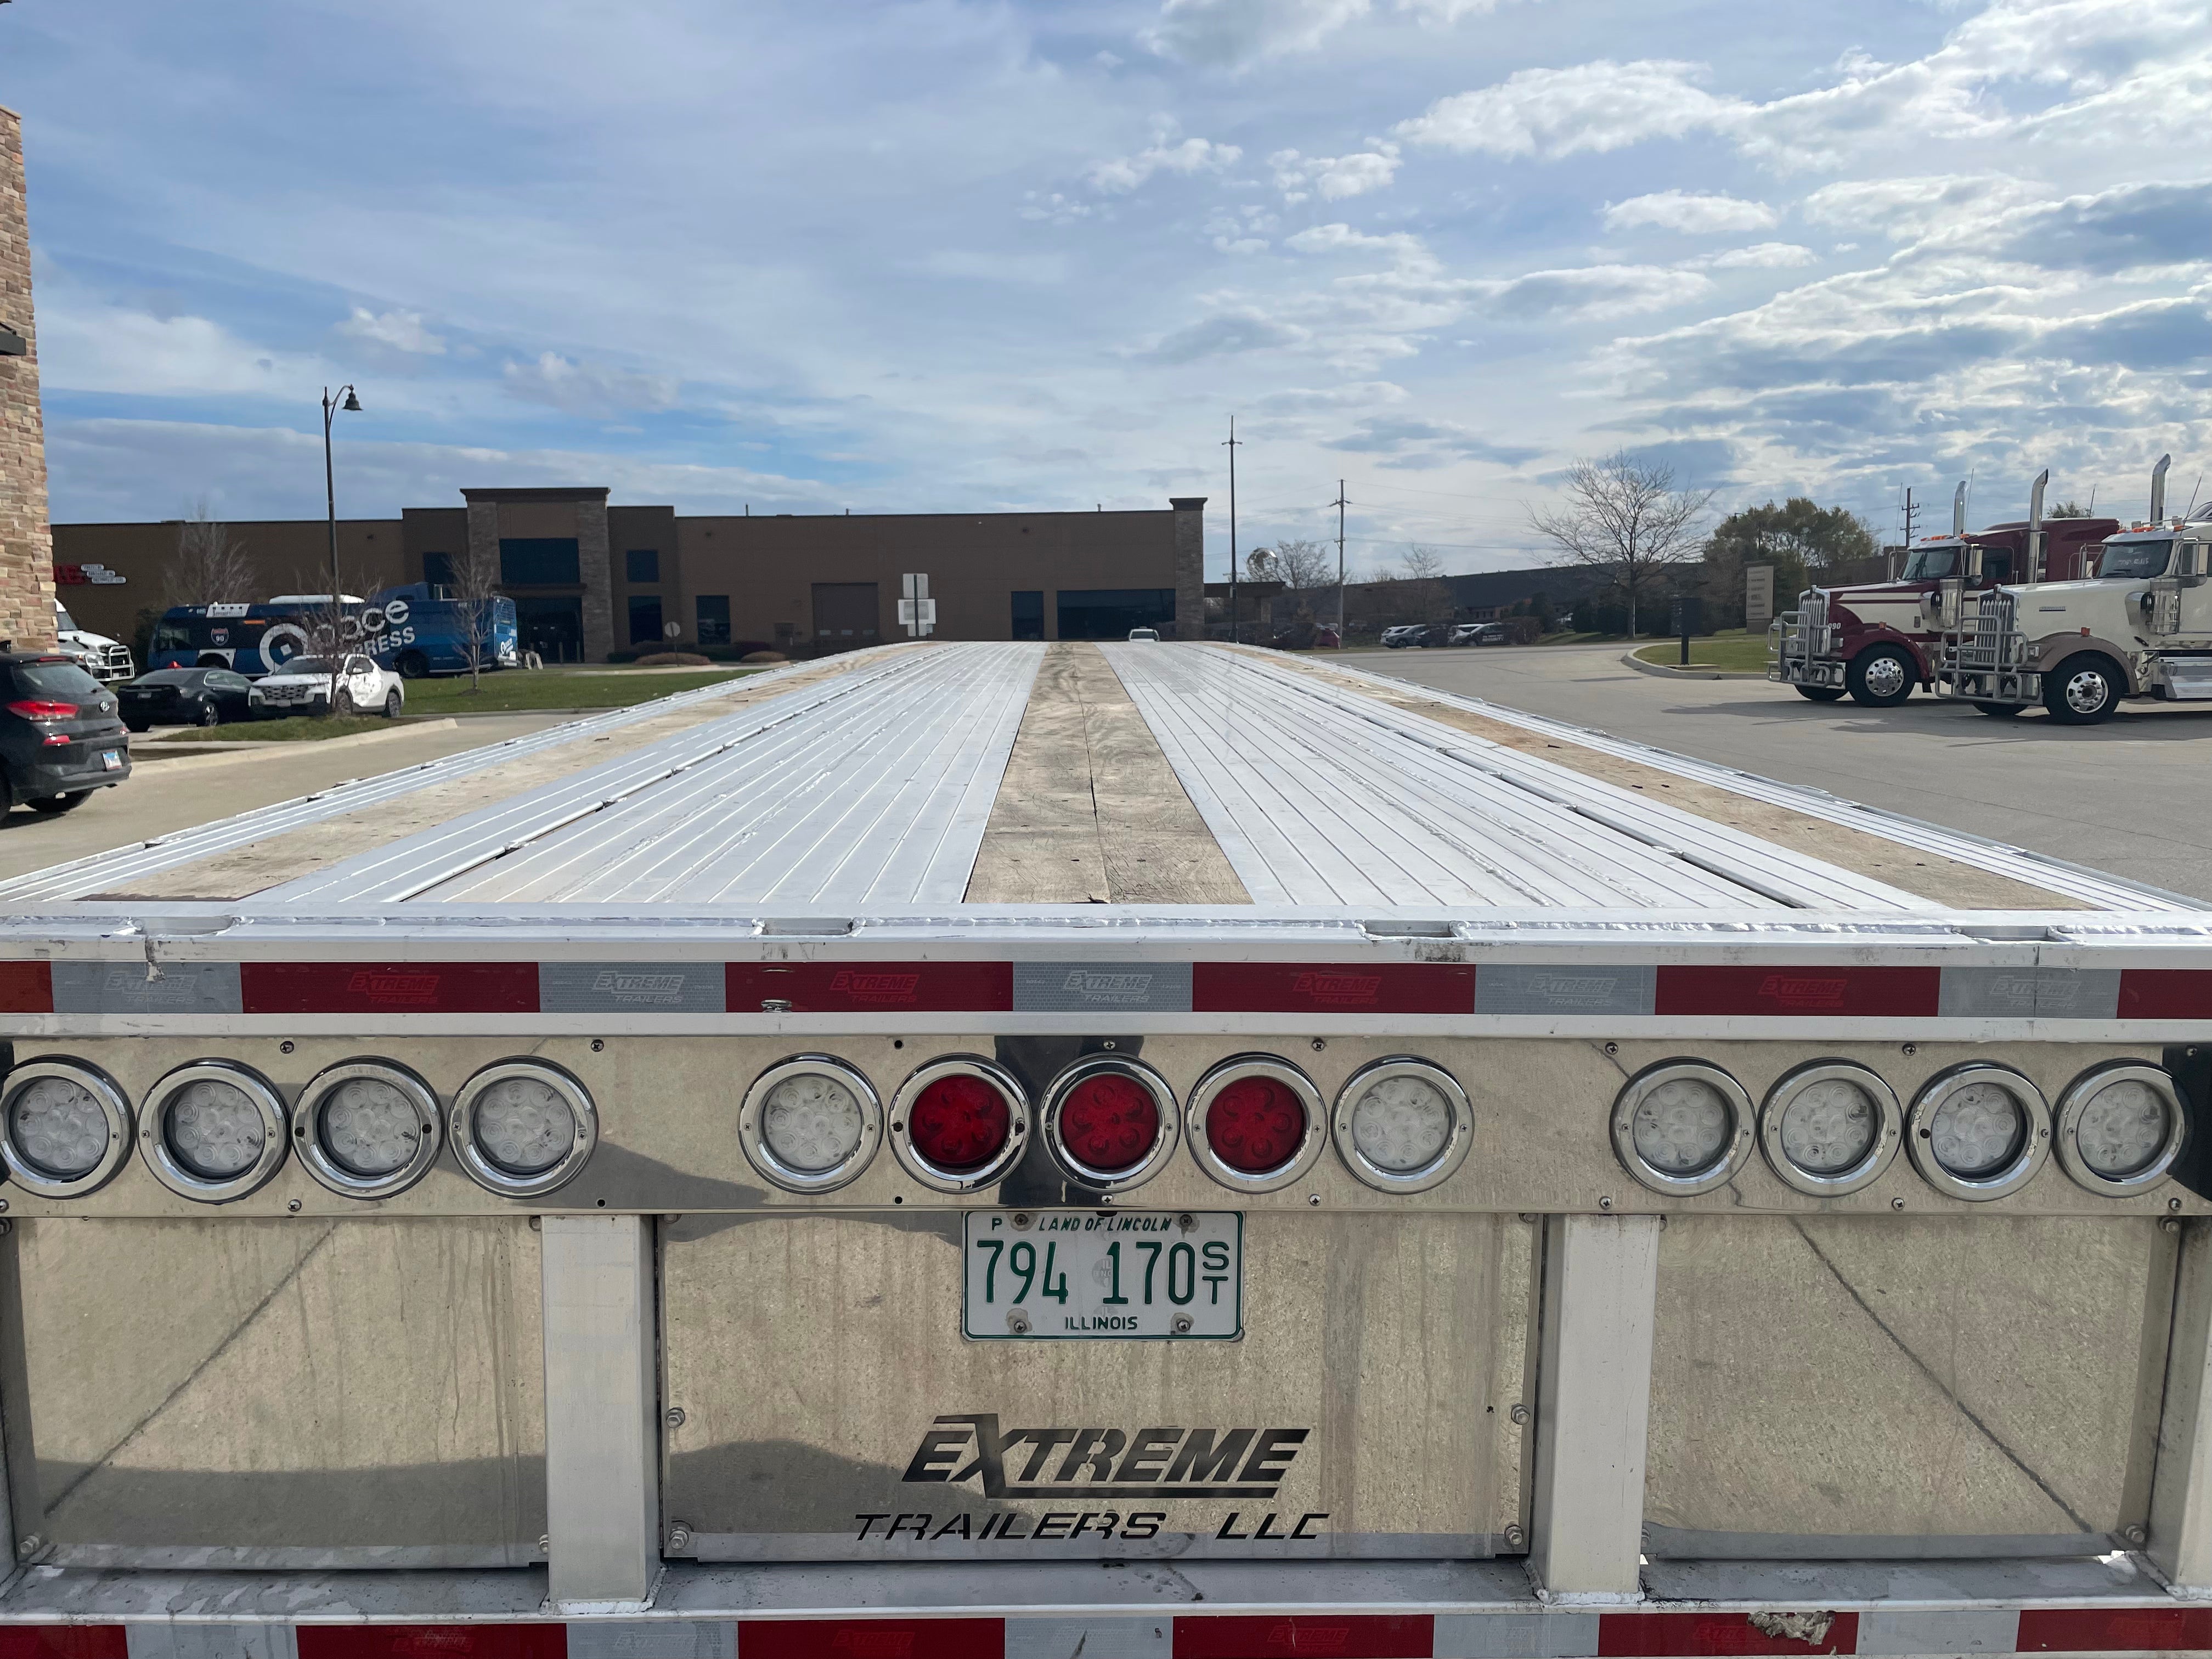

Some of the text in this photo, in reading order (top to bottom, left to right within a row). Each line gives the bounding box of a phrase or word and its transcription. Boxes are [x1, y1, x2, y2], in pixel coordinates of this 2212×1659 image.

[592, 970, 685, 994] EXTREME
[830, 970, 919, 994] EXTREME
[1063, 970, 1152, 994] EXTREME
[1293, 972, 1381, 996] EXTREME
[1085, 995, 1150, 1003] TRAILERS
[992, 1217, 1002, 1231] P
[1039, 1217, 1172, 1231] LAND OF LINCOLN
[977, 1240, 1069, 1305] 794
[1103, 1241, 1195, 1305] 170
[1065, 1317, 1138, 1330] ILLINOIS
[901, 1413, 1310, 1498] EXTREME
[855, 1512, 1329, 1541] TRAILERS LLC
